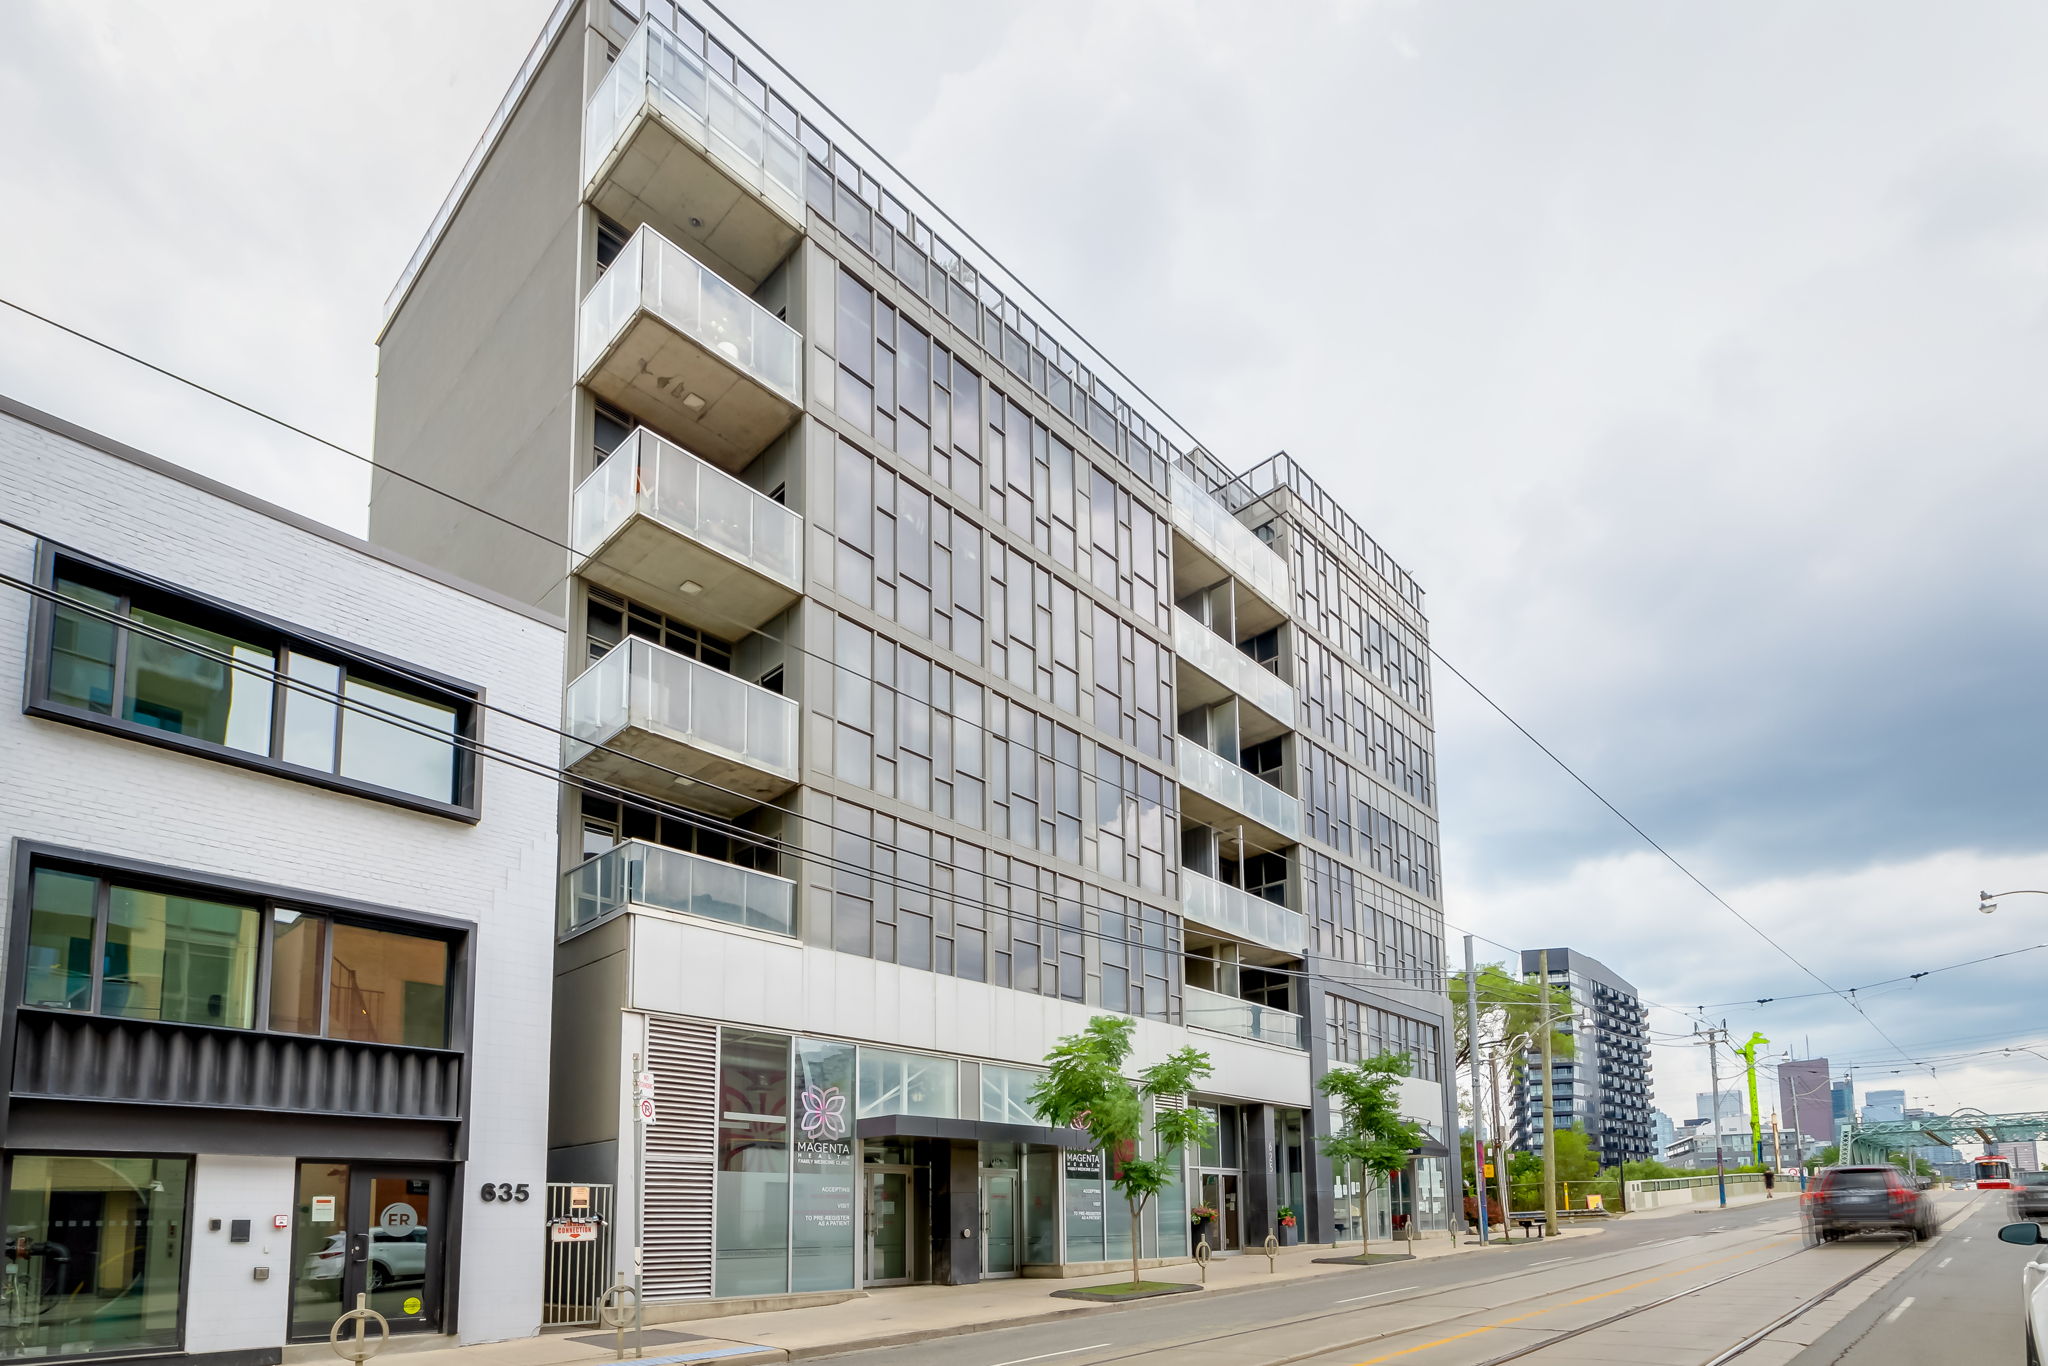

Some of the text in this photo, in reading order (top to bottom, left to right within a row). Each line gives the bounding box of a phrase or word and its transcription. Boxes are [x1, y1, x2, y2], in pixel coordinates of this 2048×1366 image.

[797, 1142, 850, 1154] MAGENTA
[1066, 1153, 1100, 1163] MAGENTA
[480, 1182, 530, 1203] 635
[388, 1213, 410, 1226] ER
[557, 1226, 592, 1234] CONNECTION
